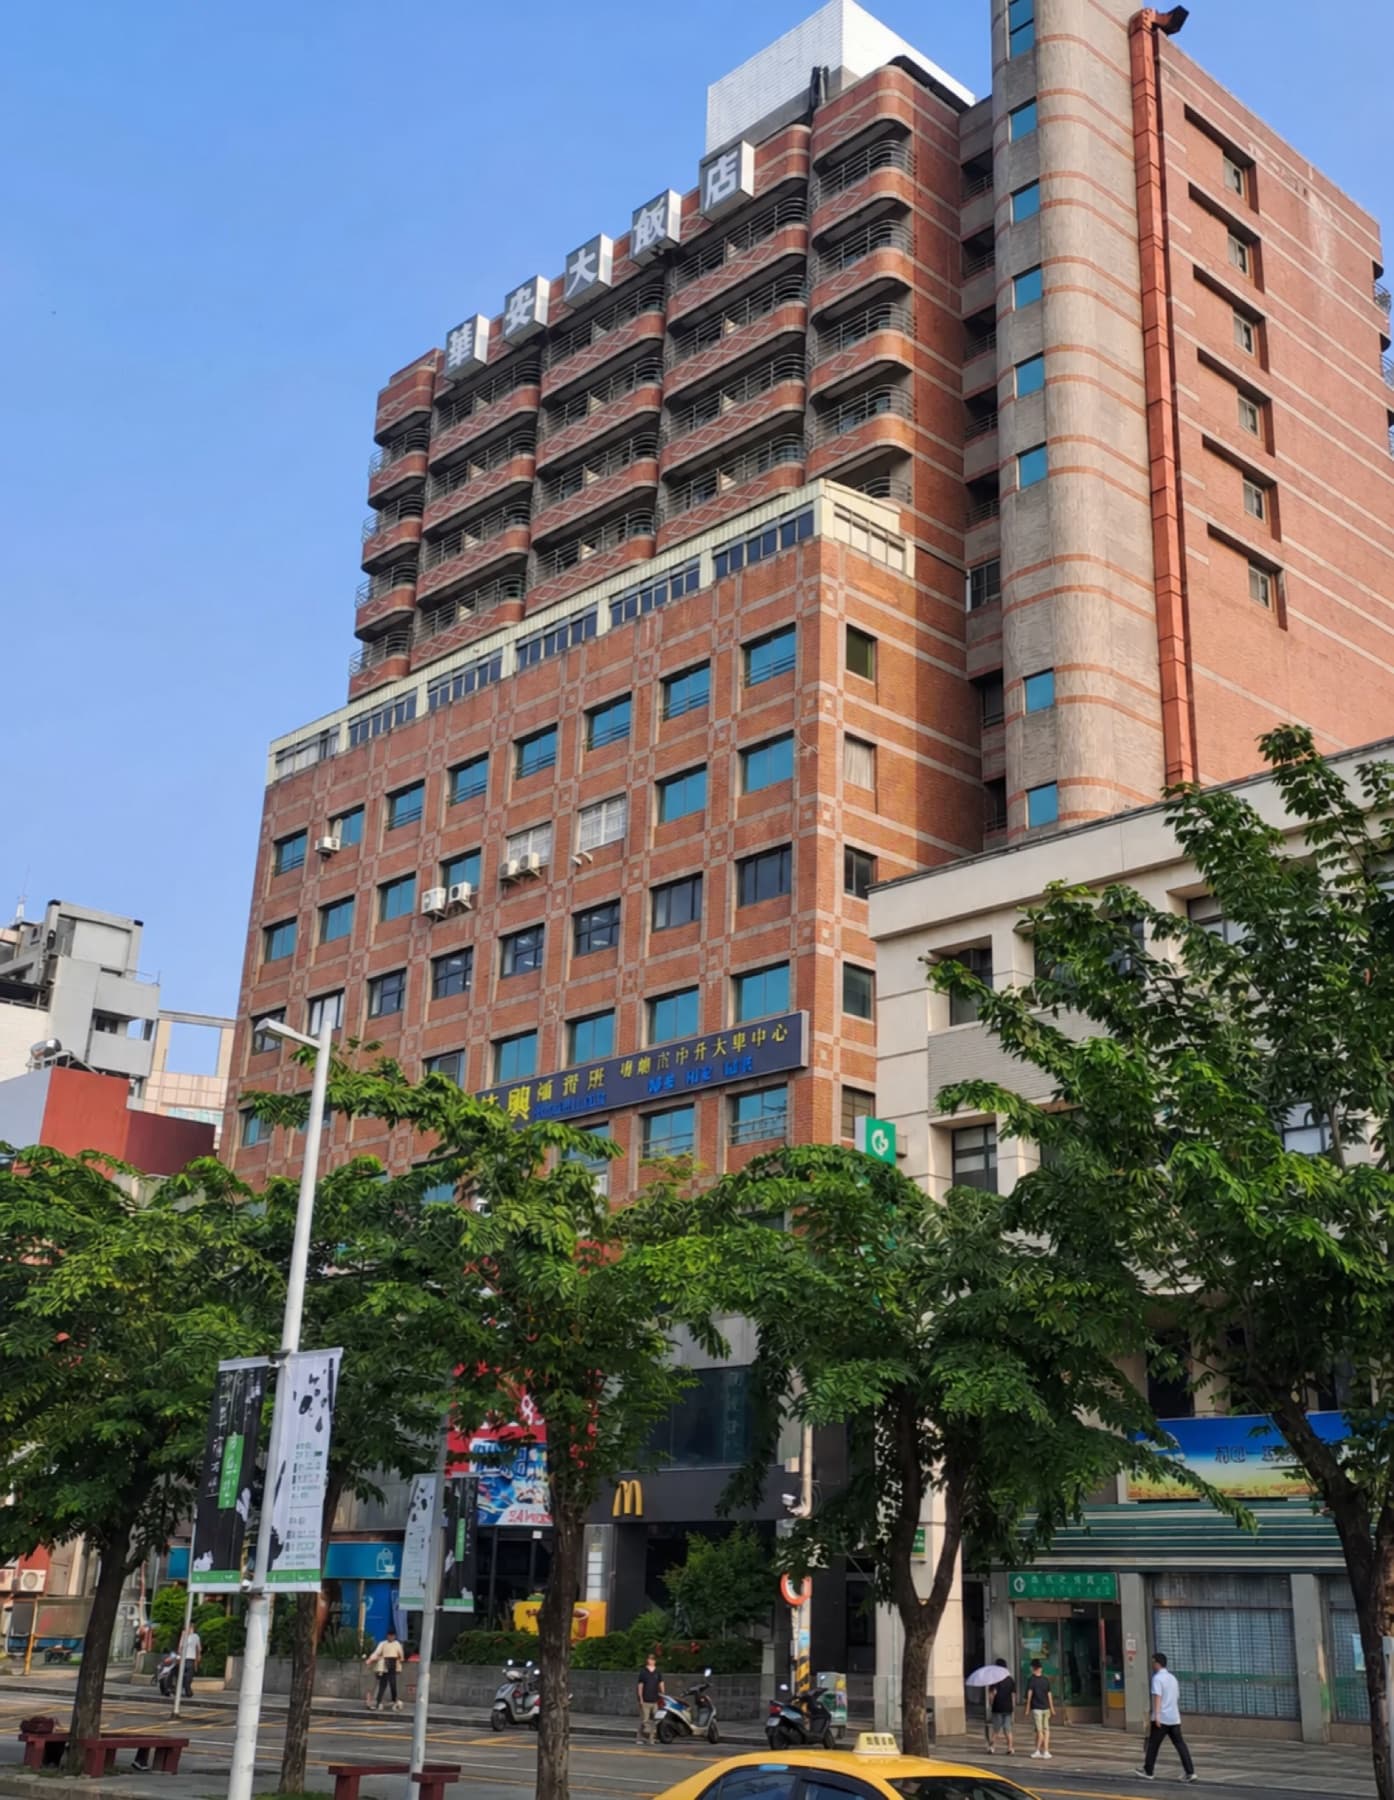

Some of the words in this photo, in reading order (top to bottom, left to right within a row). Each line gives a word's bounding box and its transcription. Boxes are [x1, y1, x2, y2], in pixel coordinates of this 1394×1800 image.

[448, 151, 739, 367] 華安大飯店
